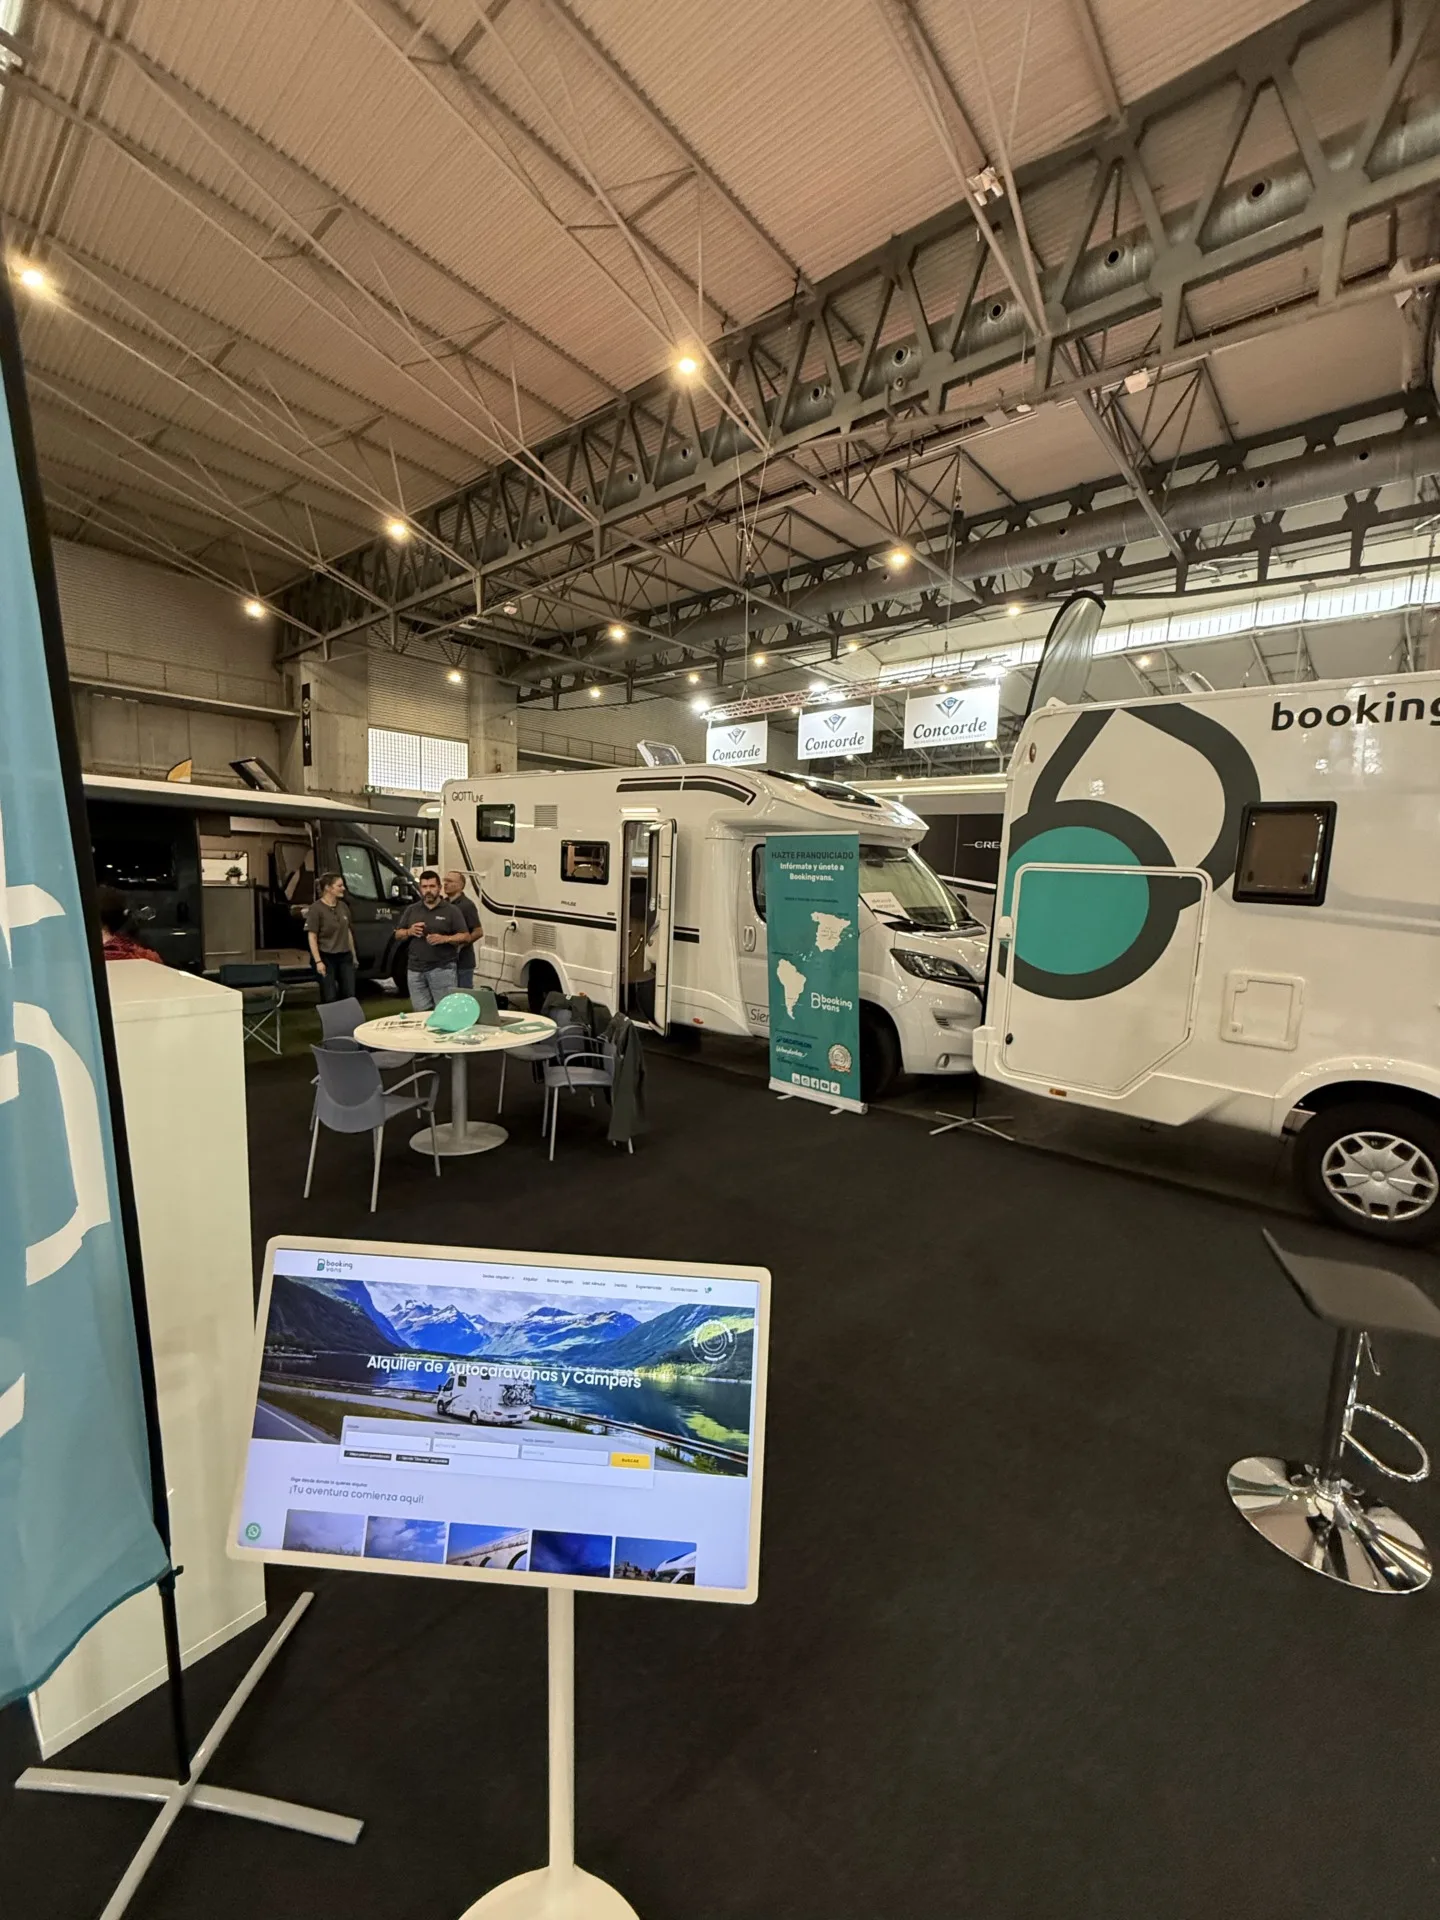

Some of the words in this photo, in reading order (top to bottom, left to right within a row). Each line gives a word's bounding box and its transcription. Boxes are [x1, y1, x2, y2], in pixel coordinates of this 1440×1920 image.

[913, 717, 987, 739] Concorde
[805, 732, 865, 751] Concorde
[712, 746, 761, 762] Concorde
[796, 852, 854, 860] FRANQUICIADO
[511, 861, 537, 874] booking
[780, 862, 812, 871] Infórmate
[818, 863, 838, 871] únete
[512, 871, 527, 879] vans
[789, 873, 834, 882] Bookingvans.
[821, 994, 853, 1011] booking
[821, 1004, 840, 1013] vans
[326, 1259, 353, 1270] booking
[366, 1355, 422, 1373] Alquiler
[424, 1360, 443, 1373] de
[447, 1361, 558, 1382] Autocaravanas
[561, 1371, 570, 1386] y
[573, 1371, 642, 1389] Campers
[289, 1484, 304, 1495] ¡Tu
[305, 1486, 349, 1498] aventura
[350, 1490, 398, 1502] comienza
[399, 1494, 424, 1505] aquí!
